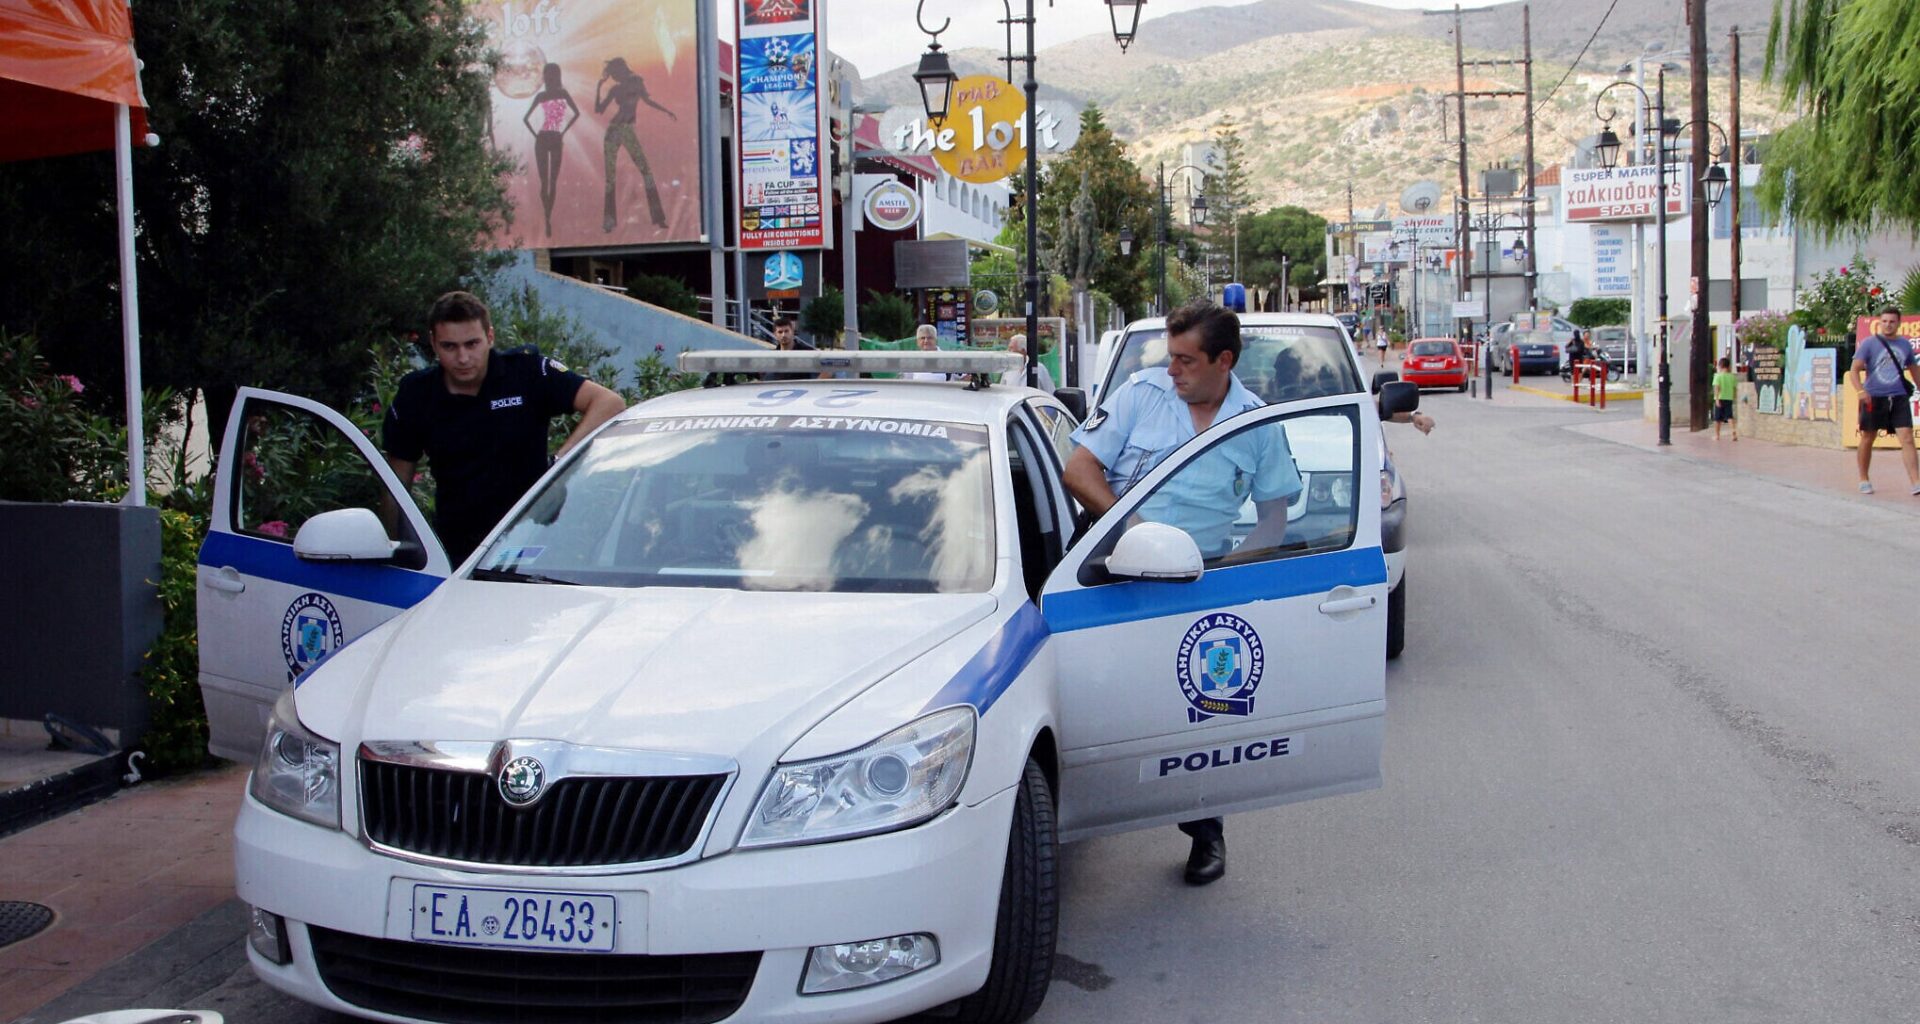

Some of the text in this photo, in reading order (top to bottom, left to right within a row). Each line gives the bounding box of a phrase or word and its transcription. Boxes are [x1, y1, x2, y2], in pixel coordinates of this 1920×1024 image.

[750, 73, 806, 83] CHAMPIONS
[764, 81, 793, 90] LEAGUE
[893, 103, 1061, 151] the loft
[960, 154, 1003, 175] BAR
[1573, 165, 1675, 182] SUPER MARKT
[1600, 203, 1645, 217] SPAR
[776, 229, 820, 237] CONDITIONED
[1240, 327, 1305, 336] ΣΤΥΝΟΜΙΑ
[490, 396, 523, 410] POLICE
[643, 416, 948, 438] ΕΛΛΗΝΙΚΗ ΑΣΤΥΝΟΜΙΑ
[282, 595, 342, 667] ΕΛΛΗΝΙΚΗ ΑΣΤΥΝΟ
[1177, 614, 1263, 701] ΕΛΛΗΝΙΚΗ ΑΣΤΥΝΟΜΙΑ
[1159, 738, 1290, 777] POLICE
[503, 897, 595, 943] 26433
